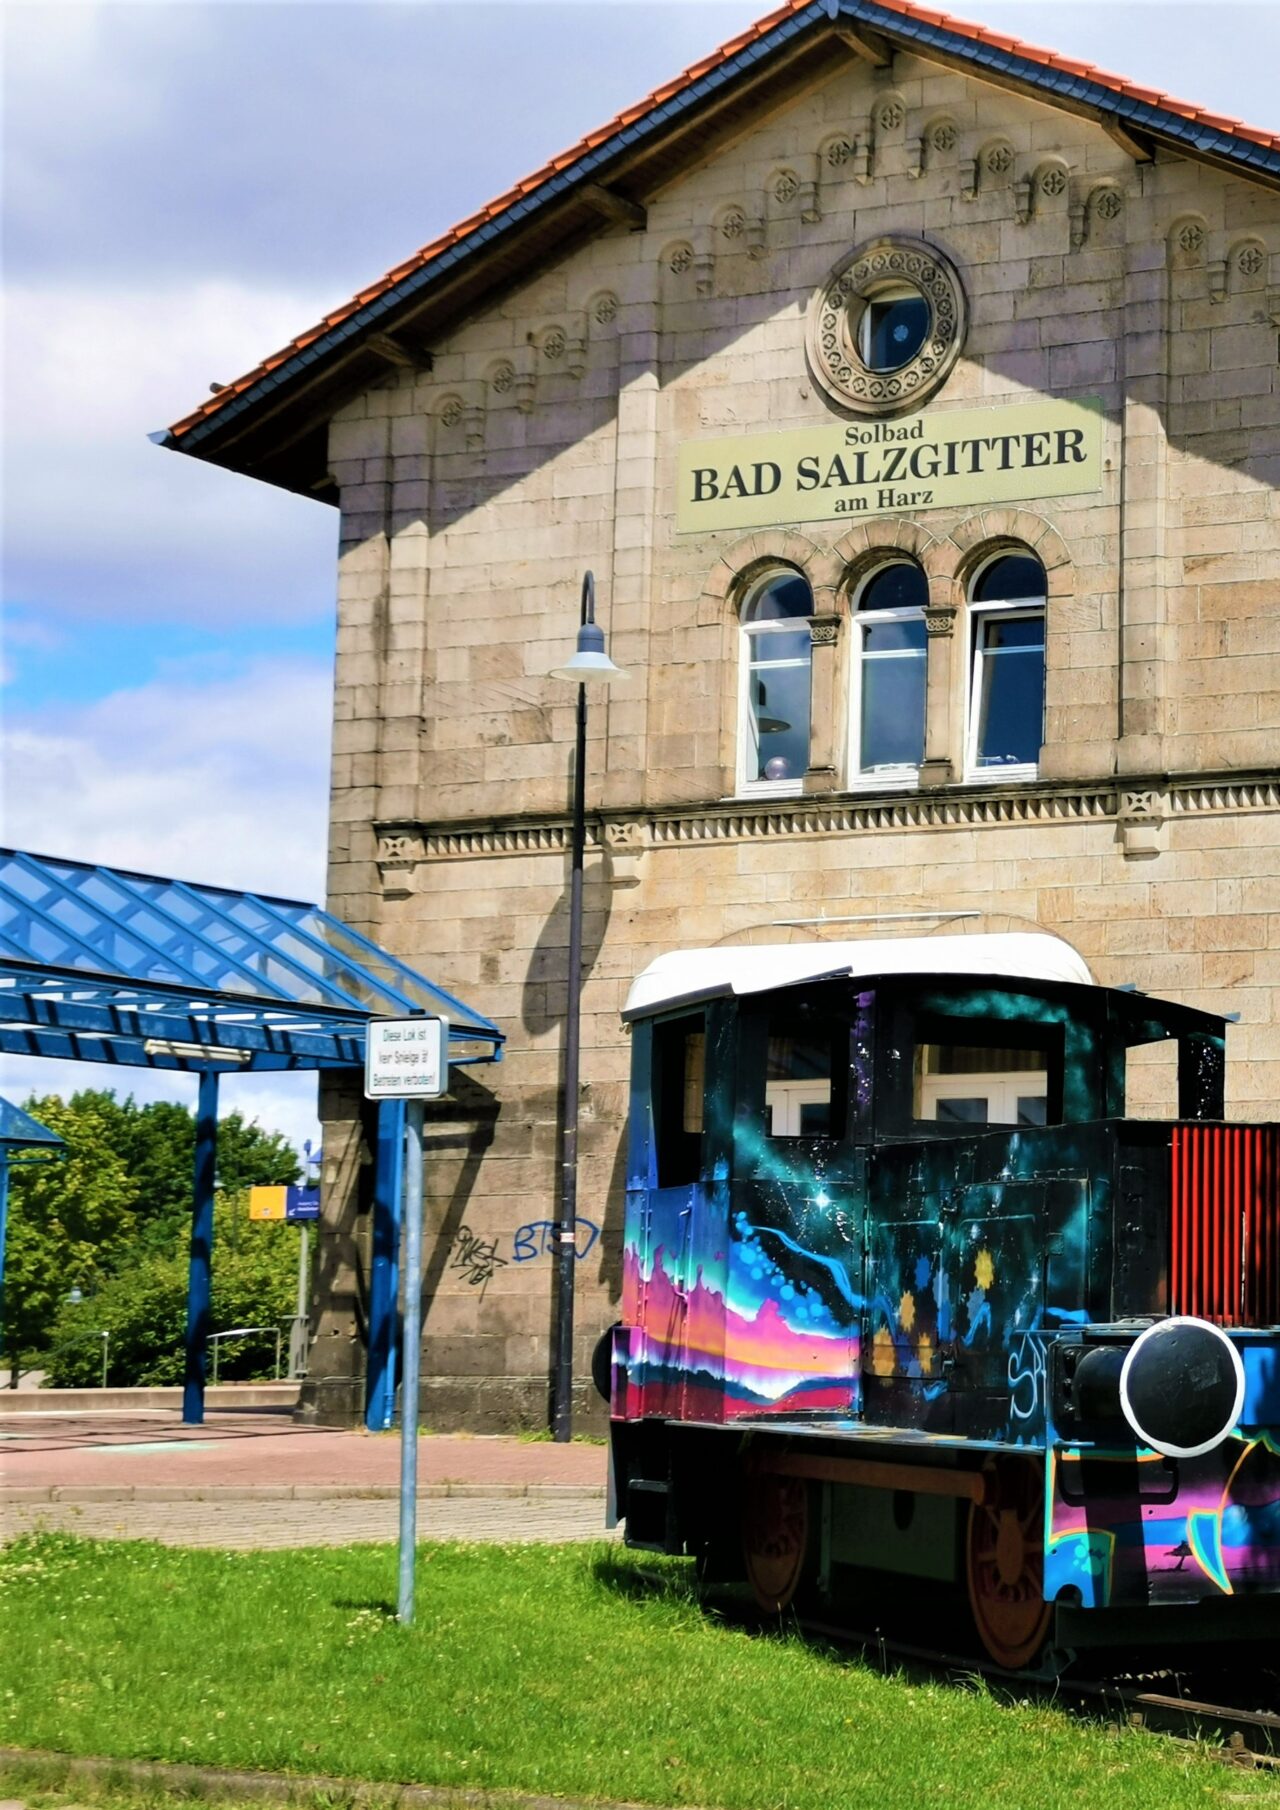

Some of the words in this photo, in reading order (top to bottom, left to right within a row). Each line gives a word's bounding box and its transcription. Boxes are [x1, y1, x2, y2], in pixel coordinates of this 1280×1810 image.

[844, 419, 925, 446] Solbad
[690, 461, 782, 503] BAD
[796, 428, 1088, 492] SALZGITTER
[834, 496, 869, 513] am
[876, 488, 934, 509] Harz
[383, 1028, 401, 1042] Diese
[403, 1027, 416, 1041] Lok
